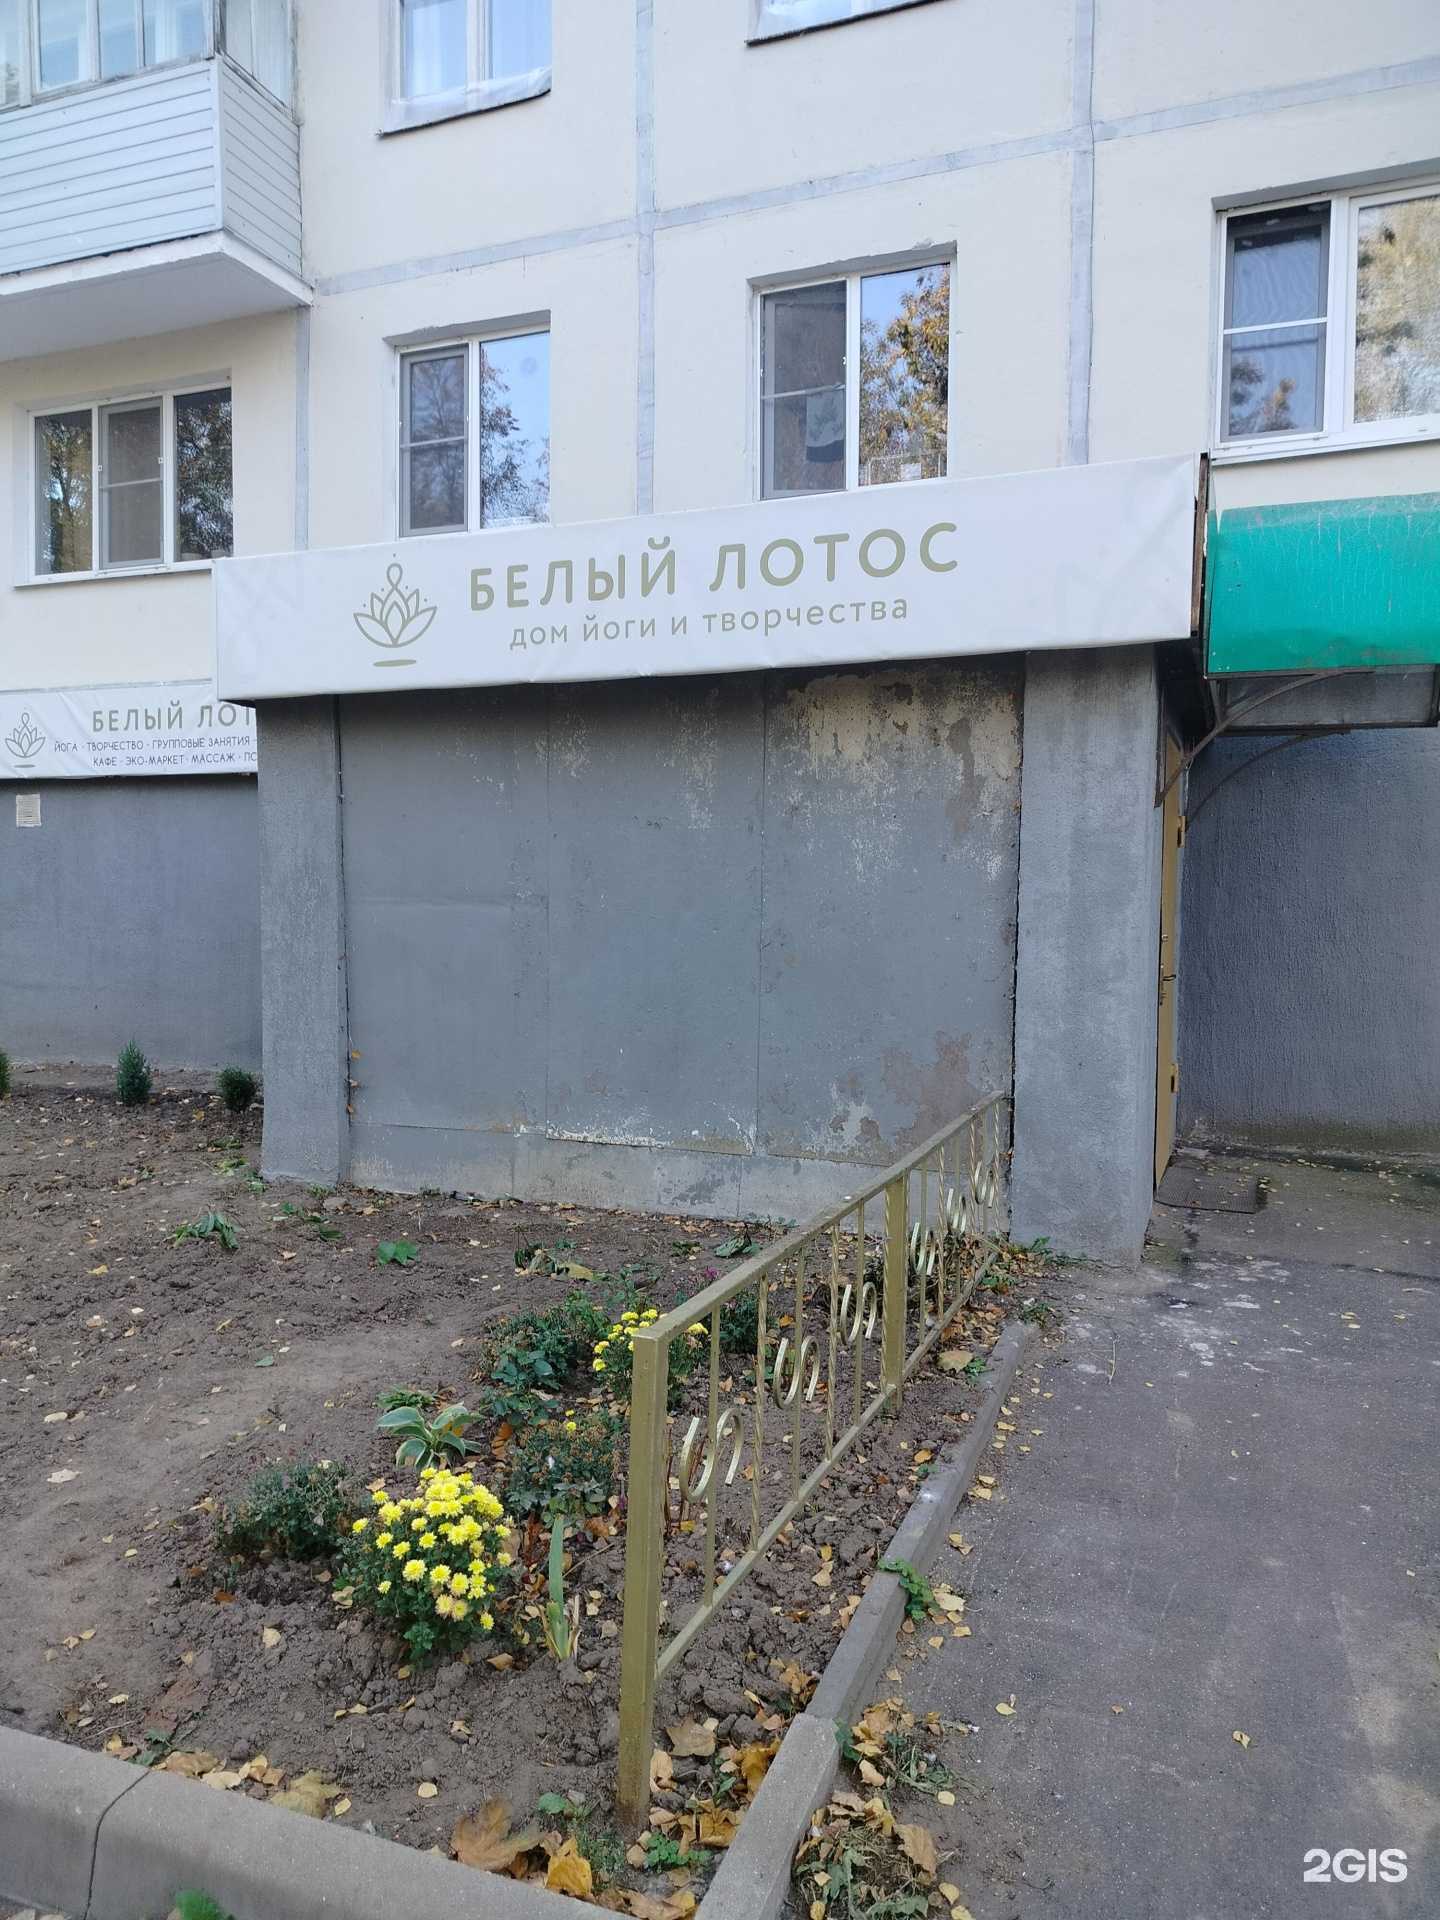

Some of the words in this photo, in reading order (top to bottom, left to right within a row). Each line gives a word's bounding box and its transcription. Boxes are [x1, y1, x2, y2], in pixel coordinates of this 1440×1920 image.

[470, 535, 676, 611] БЕЛЫЙ
[709, 522, 958, 592] ЛОТОС
[510, 624, 568, 650] дом
[583, 614, 656, 642] йоги
[671, 615, 687, 635] и
[702, 598, 908, 636] творчества
[92, 699, 183, 732] БЕЛЫЙ
[54, 740, 78, 752] ЙОГА
[87, 740, 144, 752] ТВОРЧЕСТВО
[152, 737, 205, 749] ГРУППОВЫЕ
[208, 735, 250, 747] ЗАНЯТИЯ
[93, 756, 117, 767] КАФЕ
[191, 752, 235, 764] МАССАЖ
